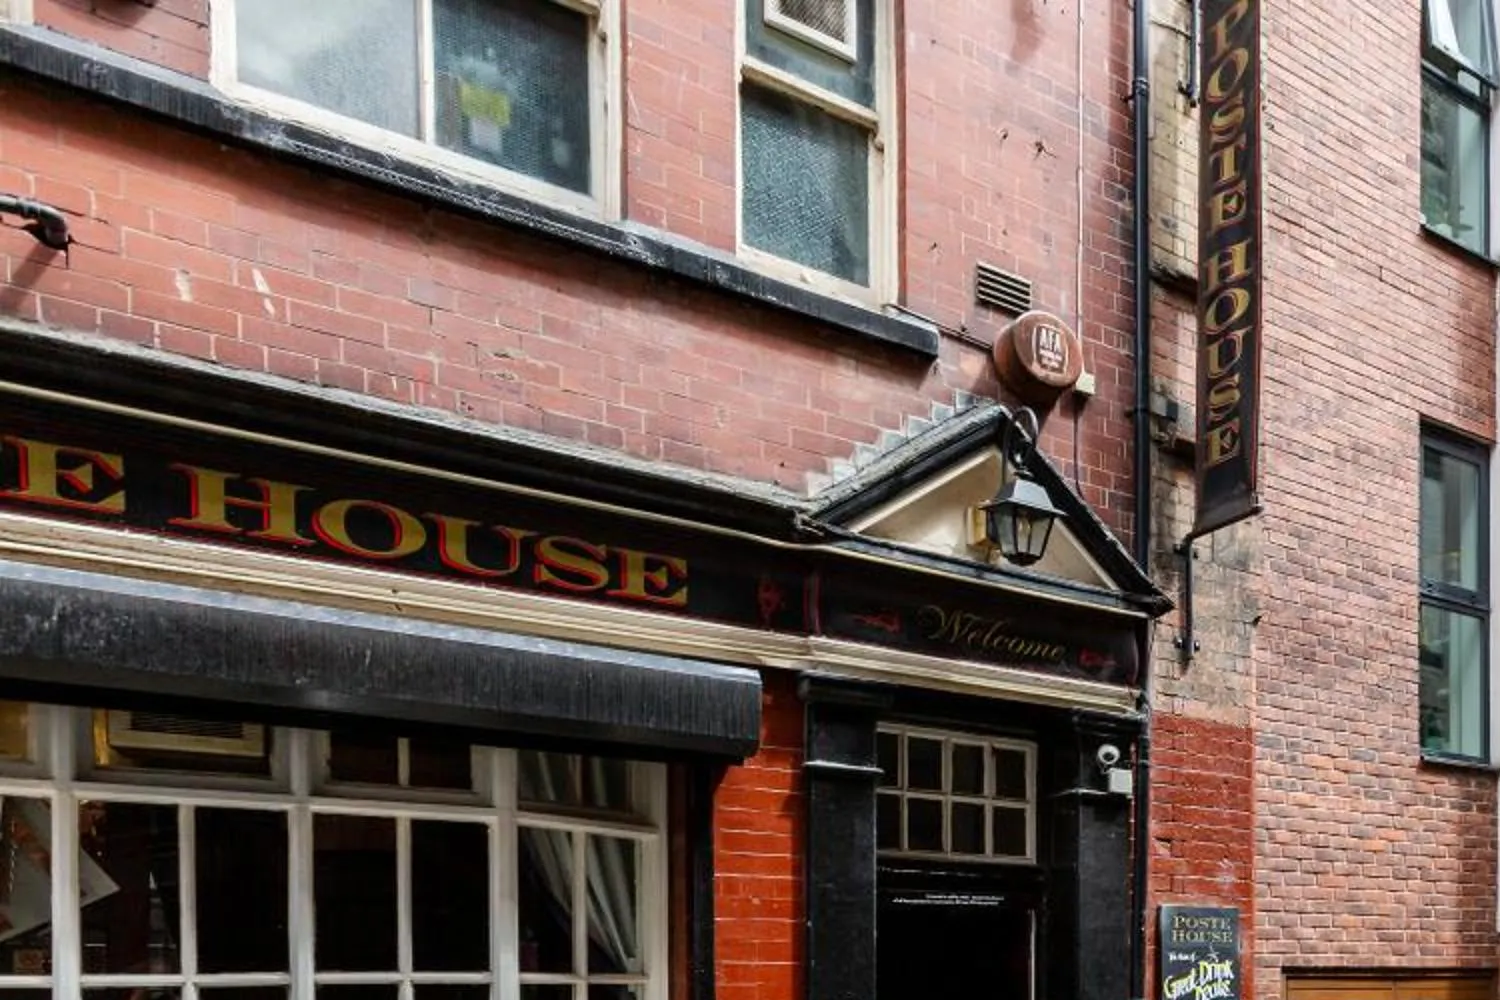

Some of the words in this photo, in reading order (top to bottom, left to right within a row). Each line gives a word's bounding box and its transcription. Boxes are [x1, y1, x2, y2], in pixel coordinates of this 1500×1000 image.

[1206, 0, 1248, 234] POSTE
[1204, 240, 1253, 466] HOUSE
[167, 462, 689, 607] HOUSE
[916, 604, 1067, 660] Welcome
[1172, 930, 1232, 943] HOUSE
[1173, 916, 1231, 930] POSTE
